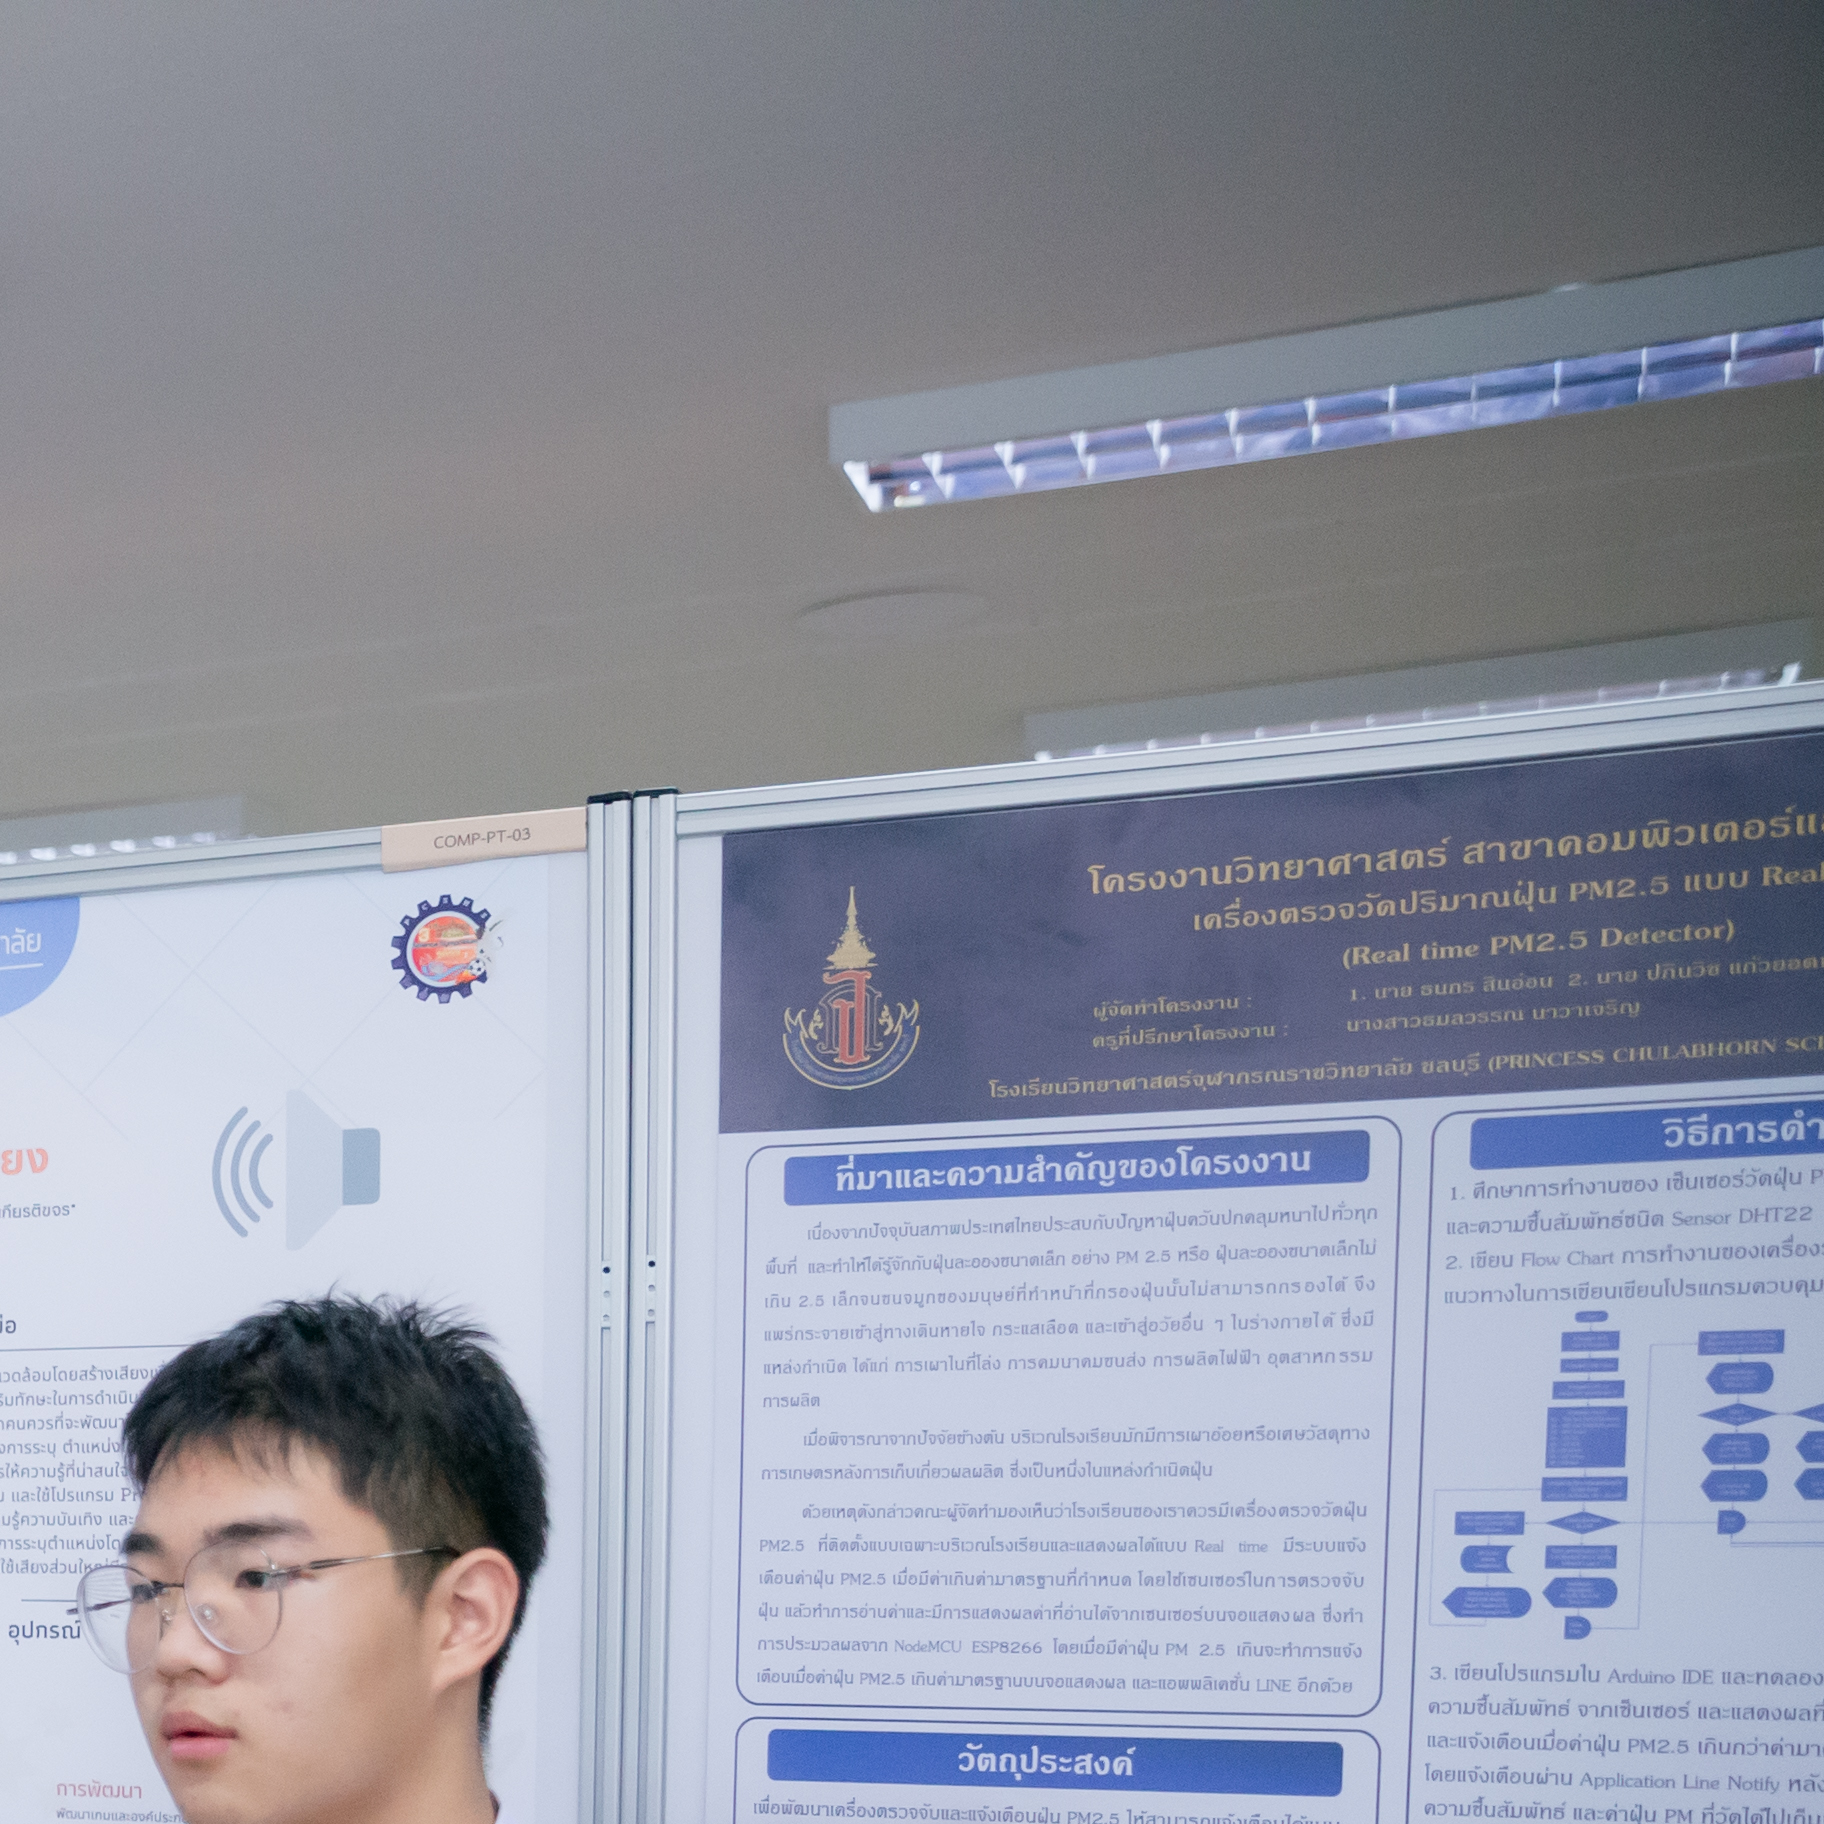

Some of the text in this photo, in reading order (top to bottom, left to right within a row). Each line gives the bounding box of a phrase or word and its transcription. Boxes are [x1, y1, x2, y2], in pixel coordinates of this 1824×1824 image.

[433, 827, 531, 849] COMP-PT-03
[1087, 836, 1452, 895] โครงงานวิทยาศาสตร์
[1568, 876, 1670, 904] PM2.5
[1684, 869, 1750, 892] แบบ
[1342, 918, 1735, 970] (Real time PM2.5 Detector)
[1488, 1048, 1604, 1074] (PRINCESS
[1612, 1037, 1778, 1064] CHULABHORN
[1672, 1209, 1732, 1227] Sensor
[1738, 1206, 1813, 1225] DHT22
[1116, 1250, 1139, 1265] PM
[1145, 1250, 1171, 1263] 2.5
[1521, 1251, 1561, 1268] Flow
[1567, 1249, 1614, 1266] Chart
[799, 1294, 825, 1308] 2.5
[759, 1538, 805, 1552] PM2.5
[1195, 1539, 1225, 1553] Real
[1238, 1540, 1268, 1553] time
[840, 1572, 886, 1586] PM2.5
[894, 1639, 962, 1654] NodeMCU
[972, 1639, 1043, 1655] ESP8266
[1165, 1642, 1188, 1657] PM
[1199, 1643, 1226, 1657] 2.5
[859, 1672, 905, 1686] PM2.5
[1256, 1678, 1292, 1693] LINE
[1607, 1668, 1676, 1685] Arduino
[1683, 1669, 1714, 1685] IDE
[1627, 1737, 1690, 1754] PM2.5
[957, 1742, 1136, 1781] วัตถุประสงค์
[1579, 1771, 1676, 1790] Application
[1683, 1773, 1720, 1790] Line
[1727, 1775, 1780, 1794] Notify
[1664, 1807, 1693, 1824] PM
